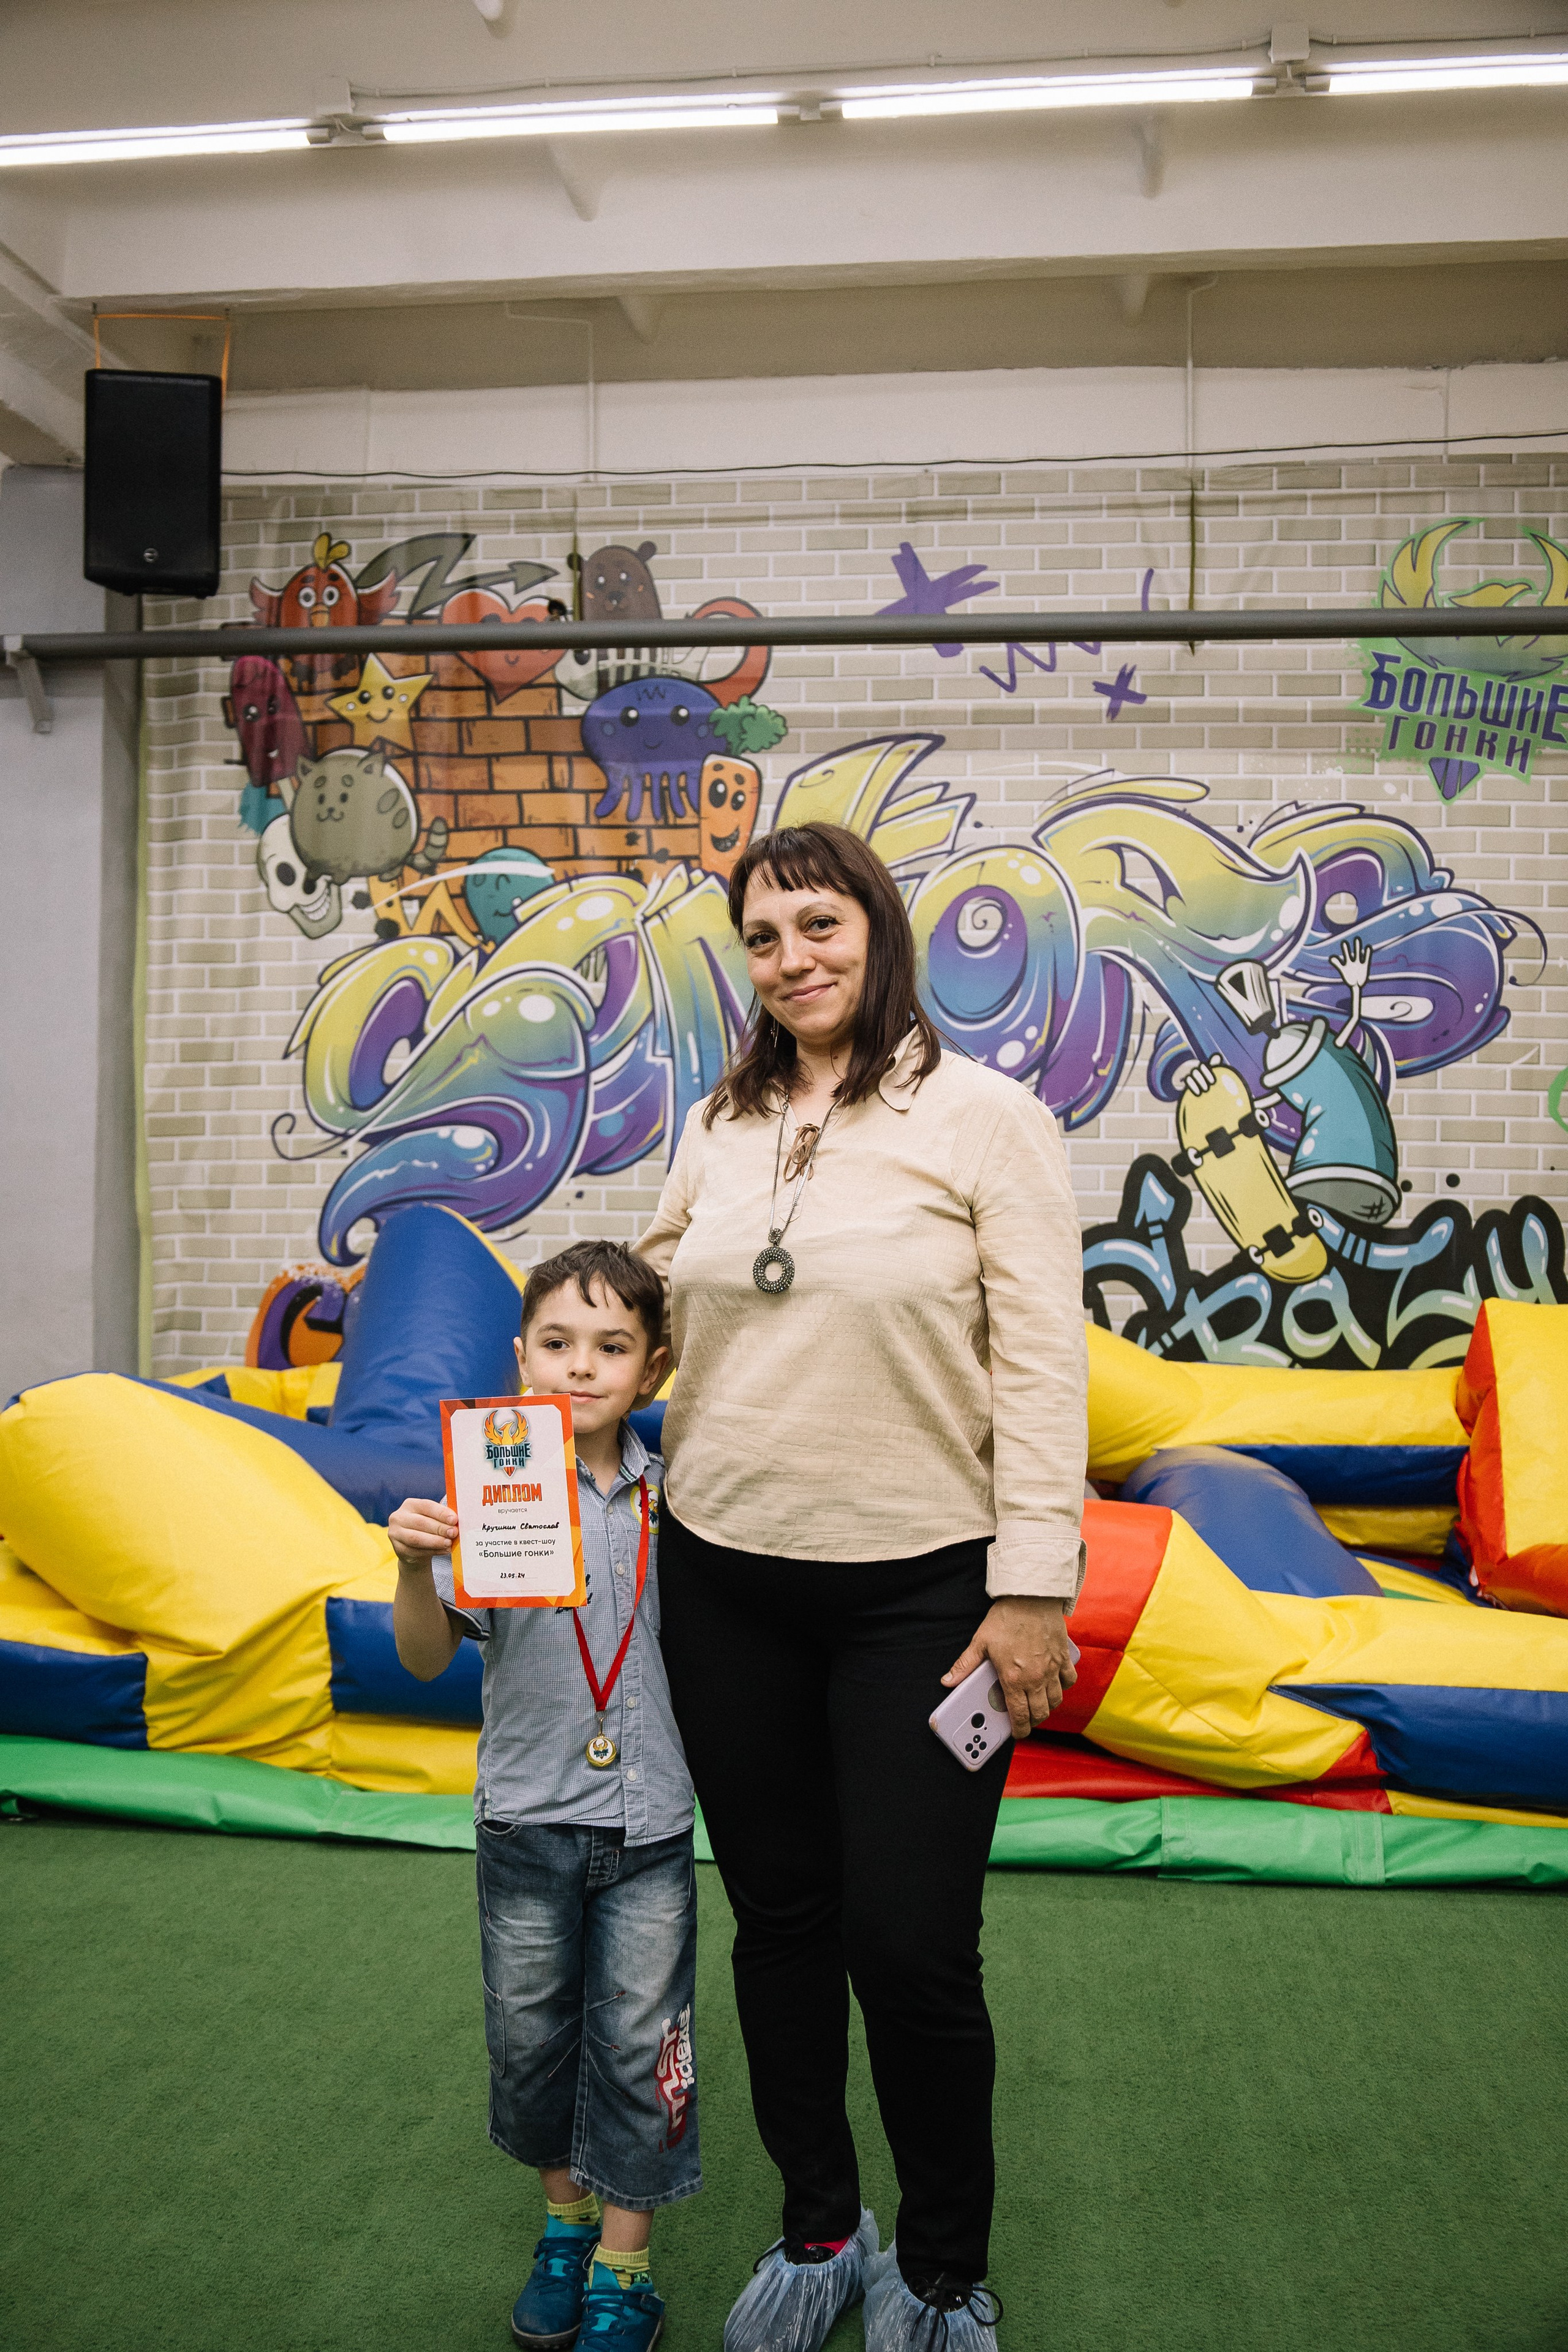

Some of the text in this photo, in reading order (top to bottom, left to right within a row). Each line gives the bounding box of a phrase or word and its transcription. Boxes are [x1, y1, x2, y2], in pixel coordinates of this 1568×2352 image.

[1362, 650, 1568, 744] БОЛЬШИЕ
[1388, 714, 1532, 774] ГОНКИ
[484, 1442, 532, 1460] БОЛЬШИЕ
[493, 1458, 525, 1468] ГОНКИ
[482, 1483, 543, 1506] ДИПЛОМ
[520, 1521, 560, 1530] Святослав
